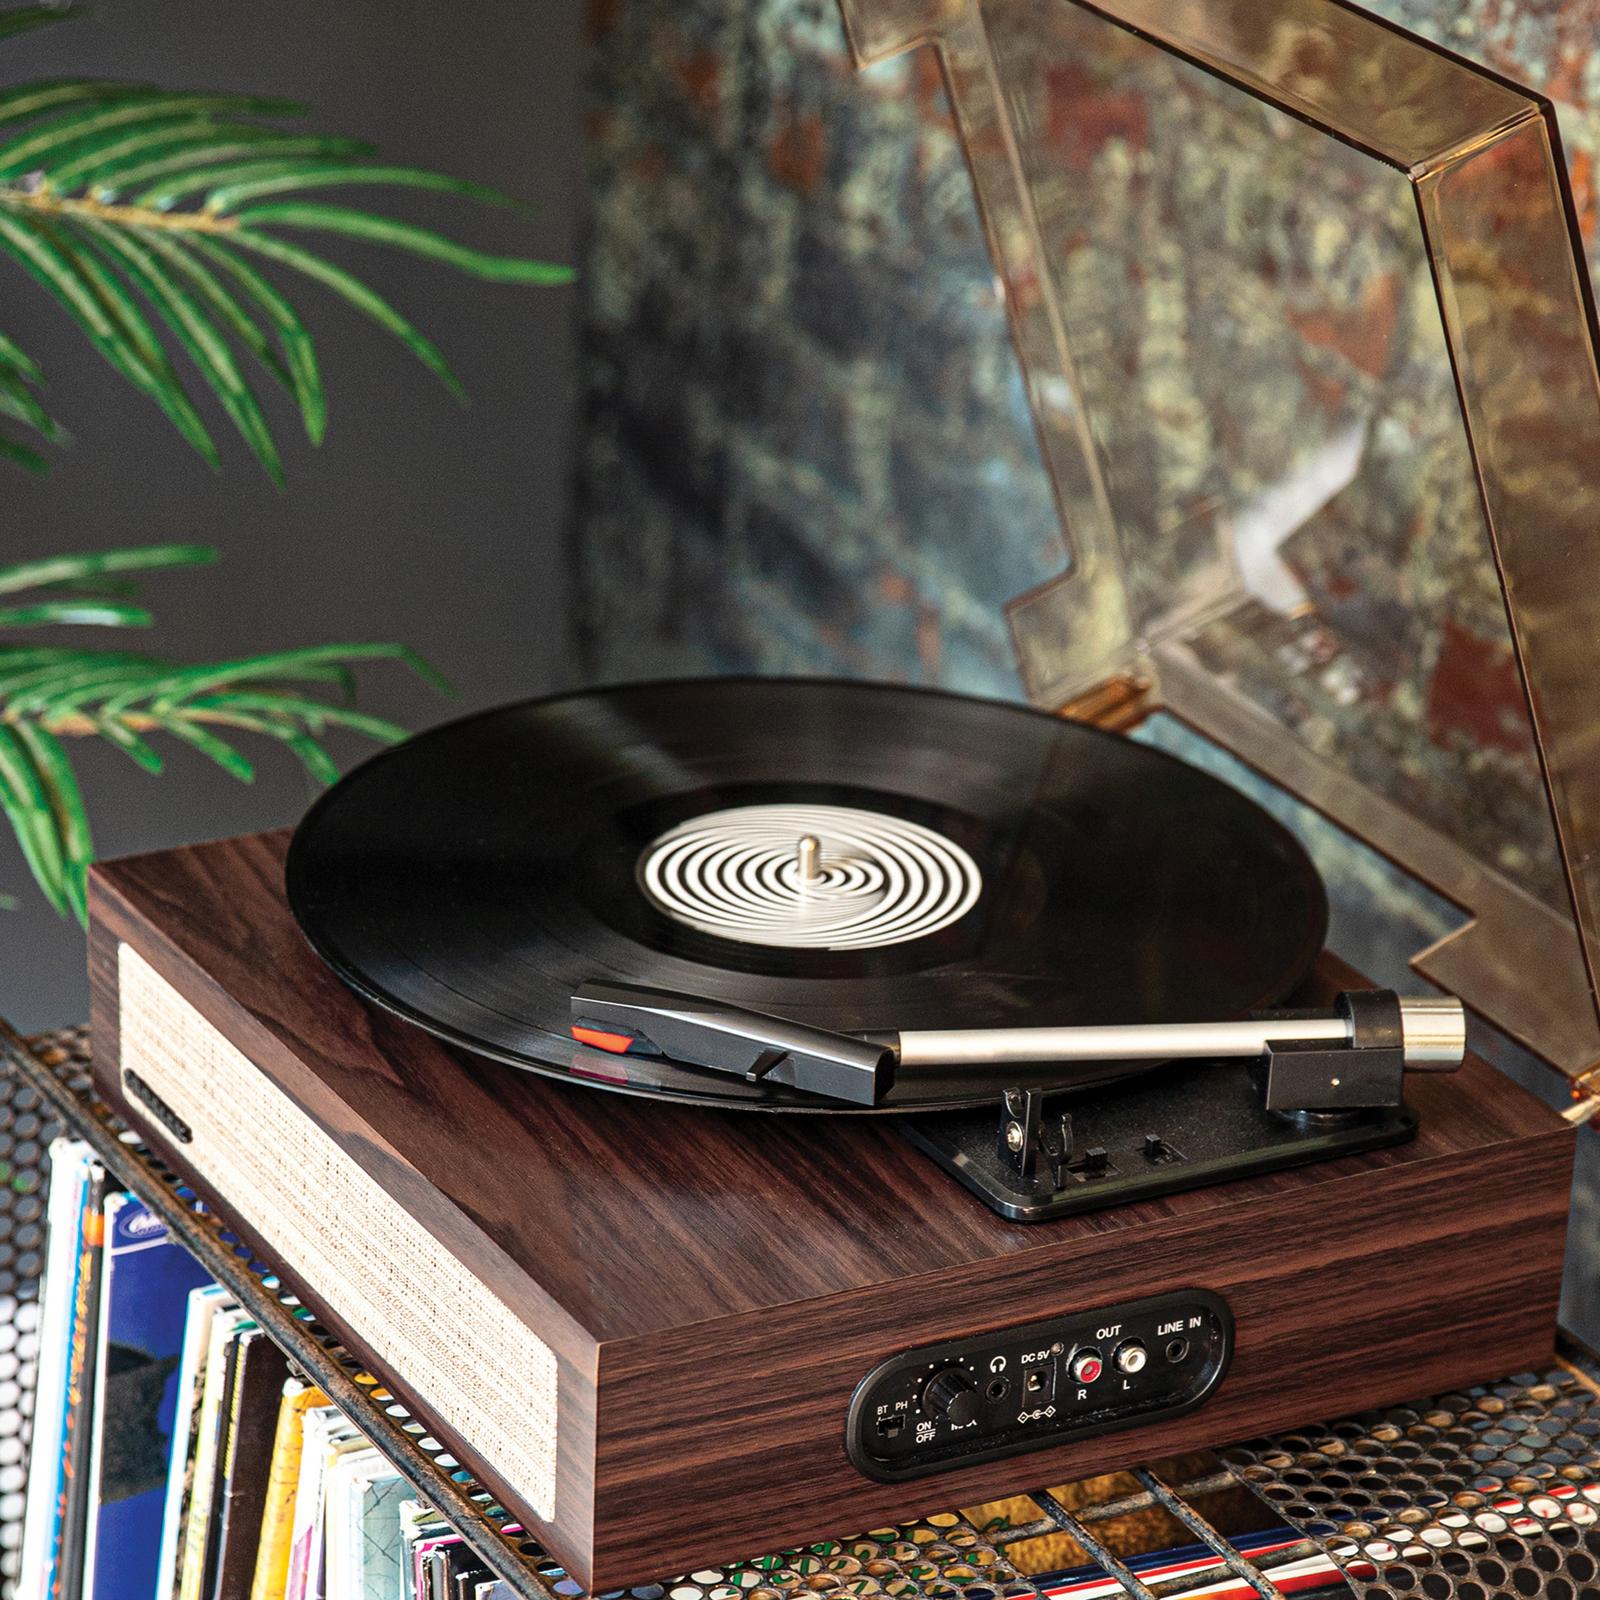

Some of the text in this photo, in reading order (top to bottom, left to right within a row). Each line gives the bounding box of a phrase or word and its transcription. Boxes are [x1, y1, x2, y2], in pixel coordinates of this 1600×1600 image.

[1096, 1324, 1122, 1340] OUT
[1157, 1316, 1202, 1336] LINE IN
[1021, 1350, 1050, 1364] DC 5V
[1123, 1380, 1131, 1390] L
[1077, 1389, 1087, 1400] R
[877, 1400, 908, 1415] BT PH
[916, 1420, 932, 1431] ON
[915, 1431, 936, 1443] OFF
